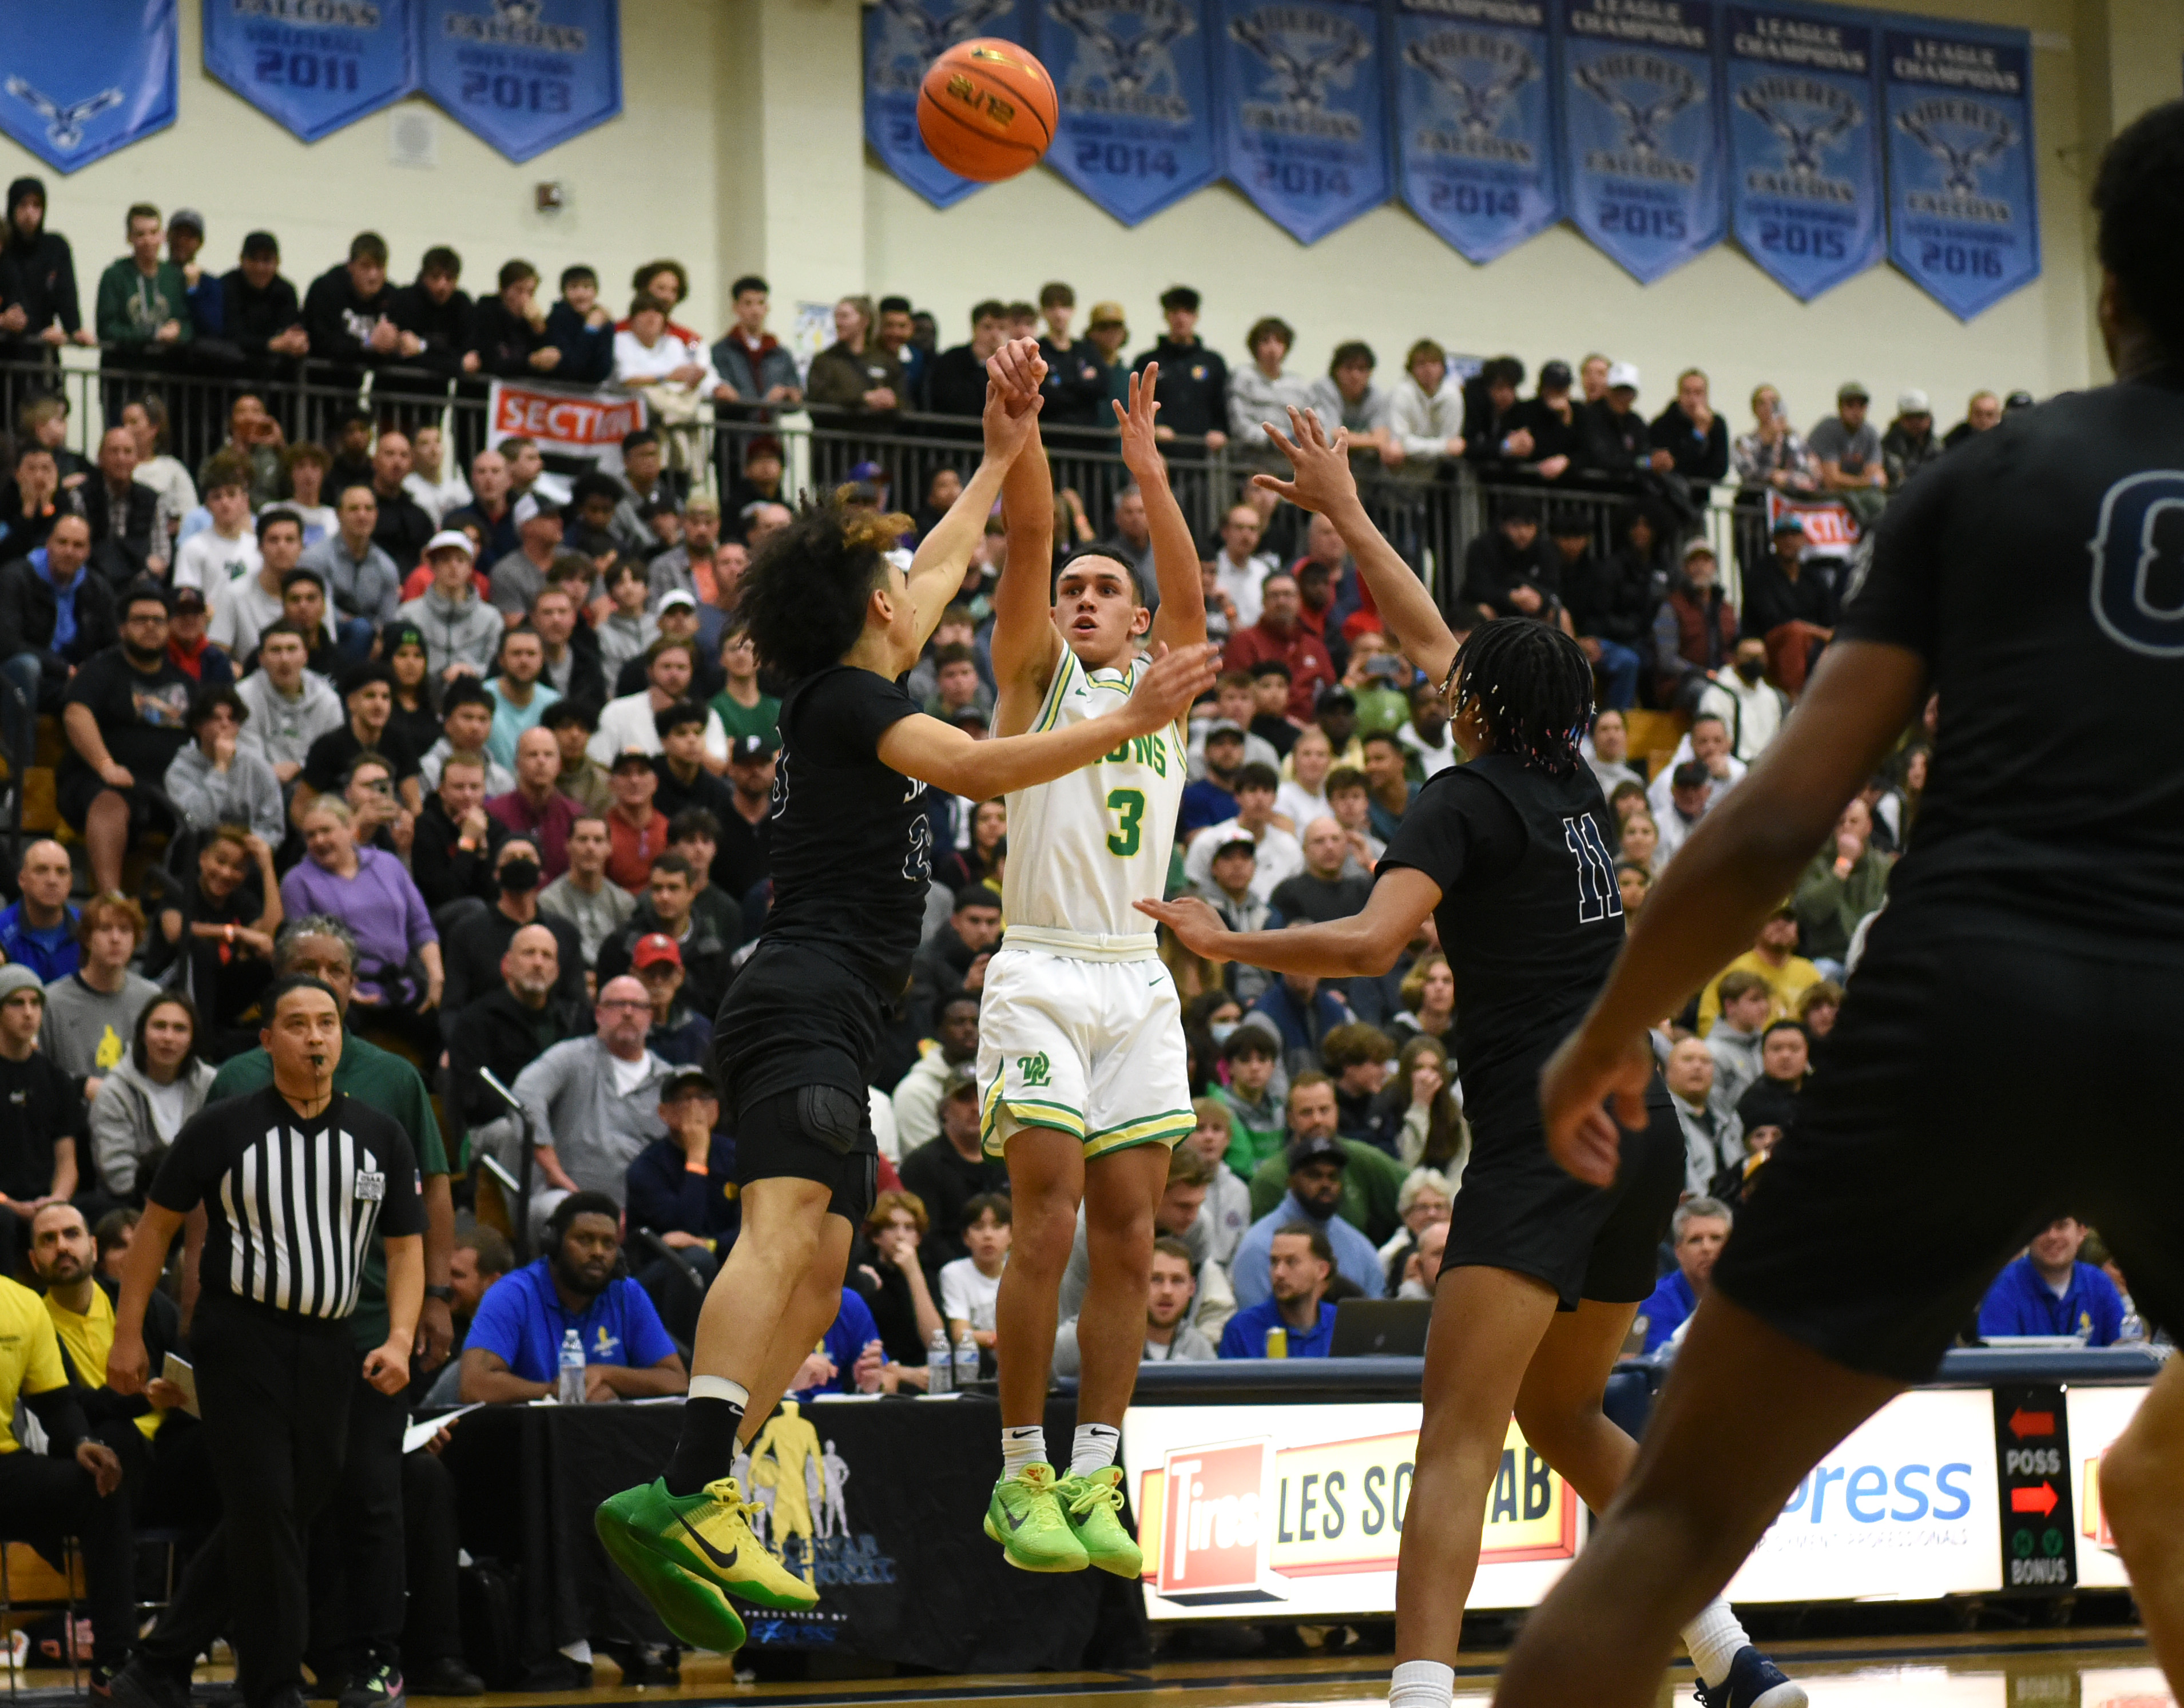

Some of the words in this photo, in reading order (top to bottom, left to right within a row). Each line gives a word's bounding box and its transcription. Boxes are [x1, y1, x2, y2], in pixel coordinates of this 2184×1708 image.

[255, 49, 359, 92] 2011
[462, 71, 572, 114] 2013
[1075, 141, 1181, 179] 2014
[1257, 162, 1352, 198] 2014
[1430, 181, 1522, 217] 2014
[1600, 202, 1687, 240] 2015
[1759, 221, 1846, 260] 2015
[1922, 240, 2003, 278] 2016
[1105, 787, 1146, 859] 3
[1563, 812, 1623, 923] 11
[2007, 1448, 2060, 1475] POSS
[1278, 1471, 1345, 1543] LES
[1363, 1447, 1551, 1535] SCAB
[2012, 1558, 2067, 1584] BONUS
